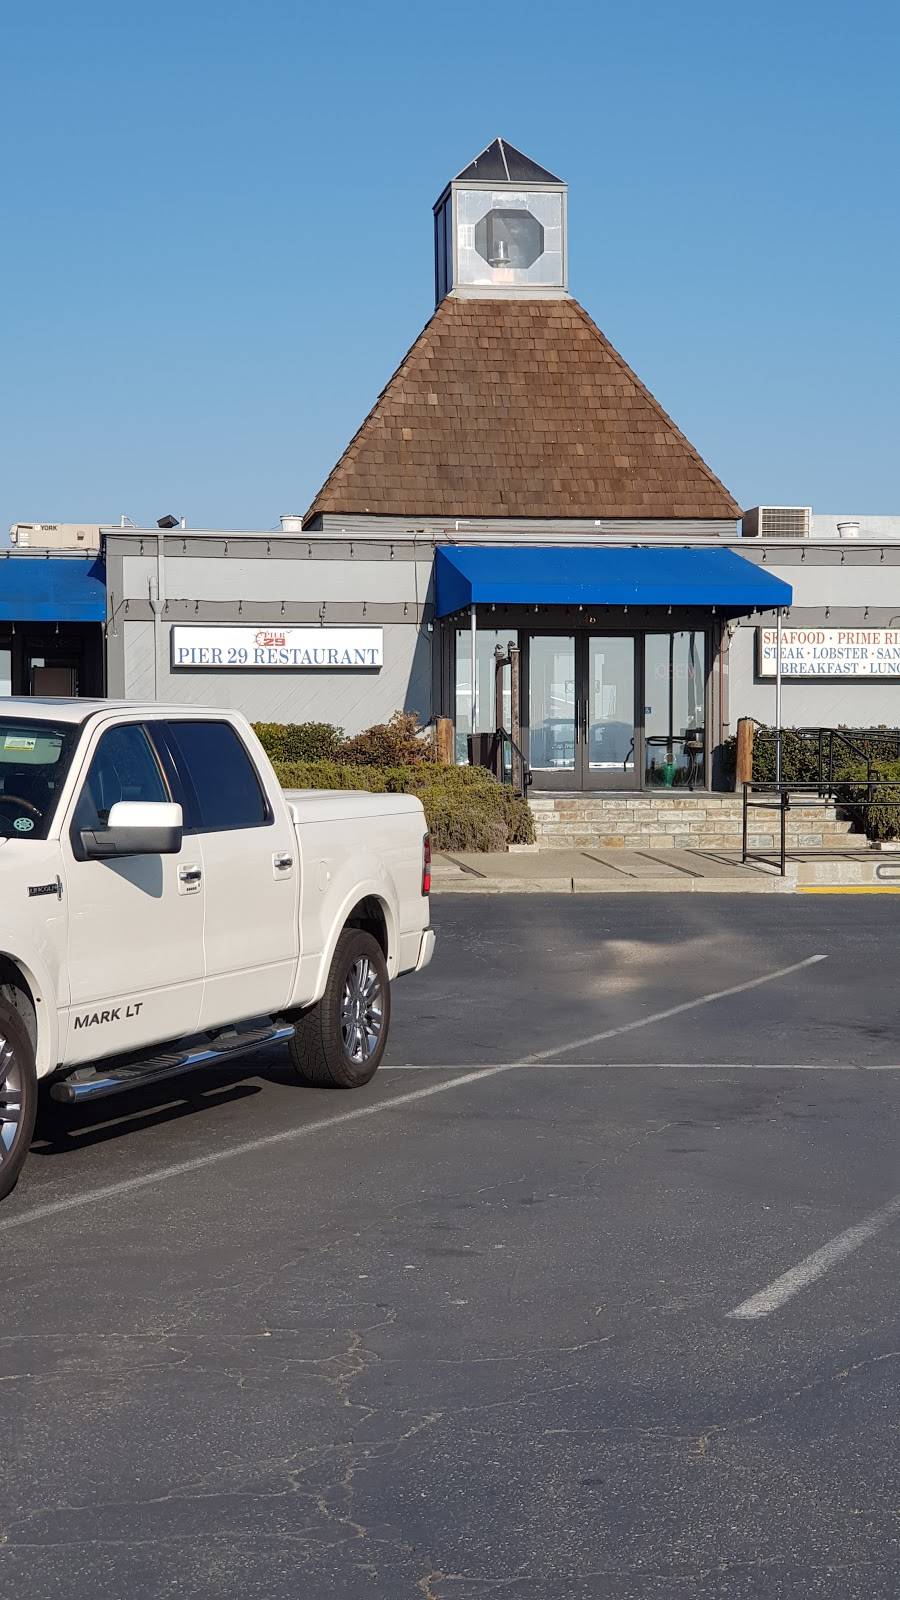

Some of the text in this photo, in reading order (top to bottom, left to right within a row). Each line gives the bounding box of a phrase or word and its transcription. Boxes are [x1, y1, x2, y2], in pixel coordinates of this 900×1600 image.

[263, 638, 286, 646] 29
[763, 631, 826, 645] SEAFOOD
[837, 632, 881, 645] PRIME
[177, 647, 379, 665] PIER 29 RESTAURANT
[763, 647, 805, 659] STEAK
[813, 647, 868, 659] LOBSTER
[780, 662, 859, 674] BREAKFAST
[74, 1002, 143, 1030] MARK LT
